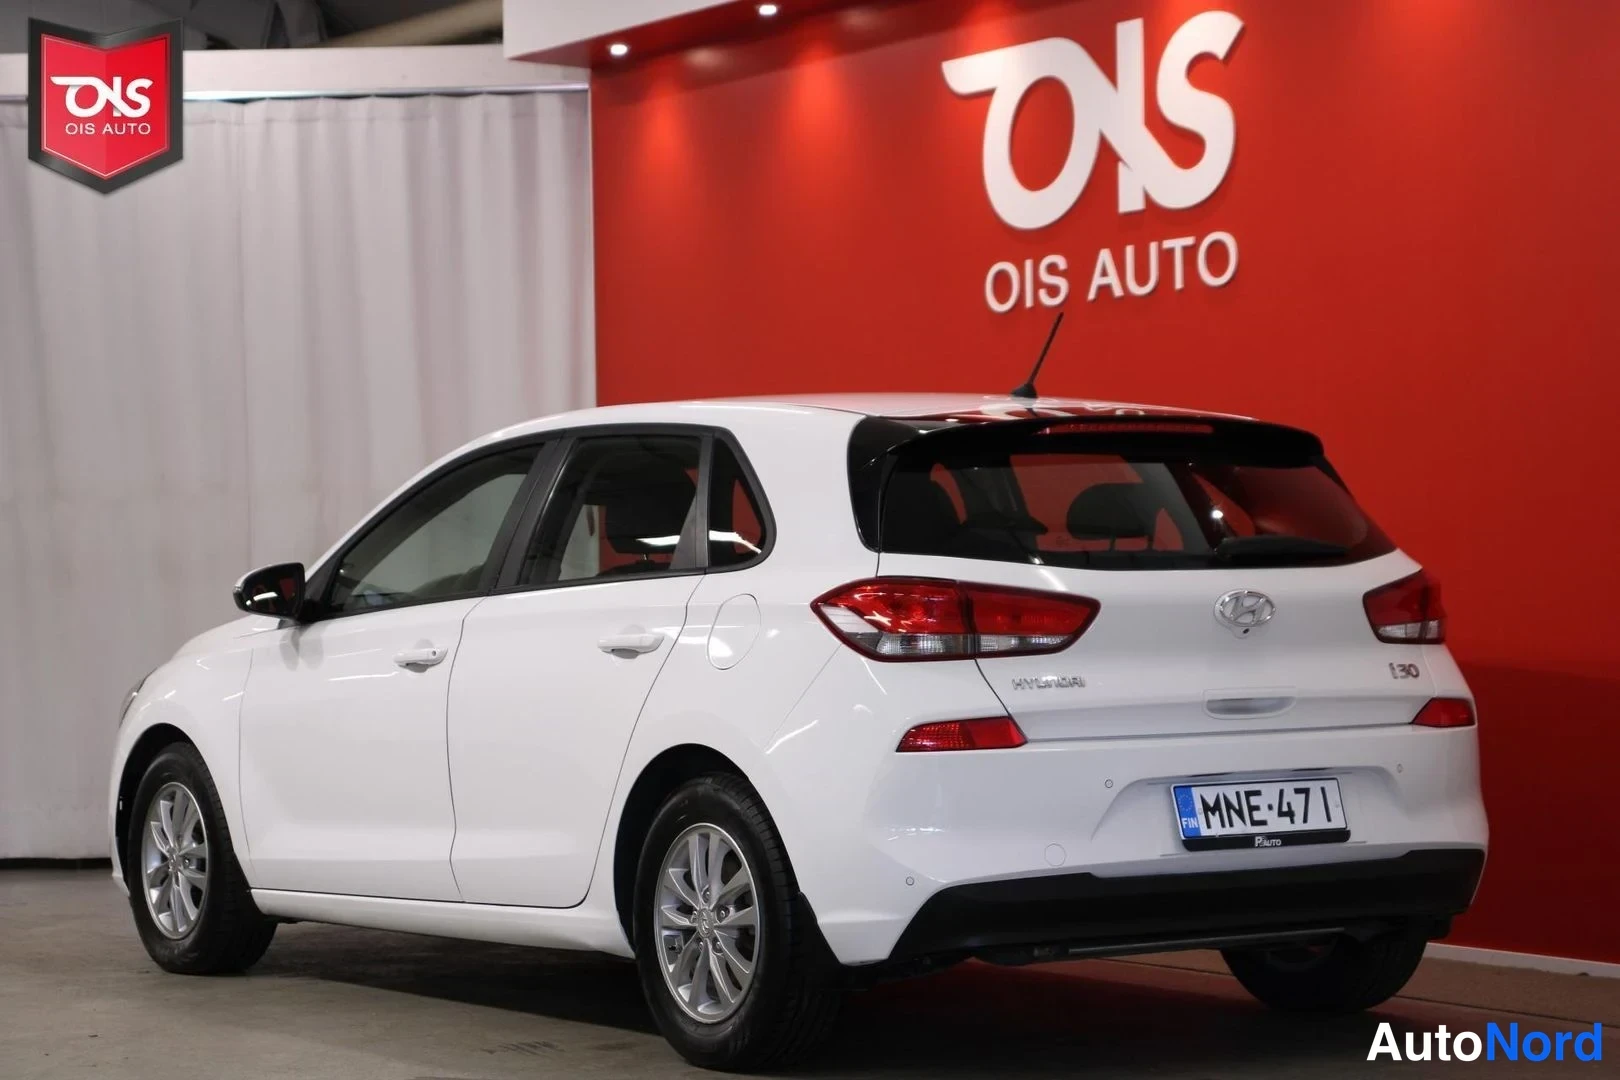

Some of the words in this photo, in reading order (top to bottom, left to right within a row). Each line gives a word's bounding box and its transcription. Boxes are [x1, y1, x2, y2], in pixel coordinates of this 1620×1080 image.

[984, 254, 1069, 314] OIS
[1087, 231, 1239, 302] AUTO
[1388, 662, 1420, 679] i30
[1182, 816, 1199, 829] FIN
